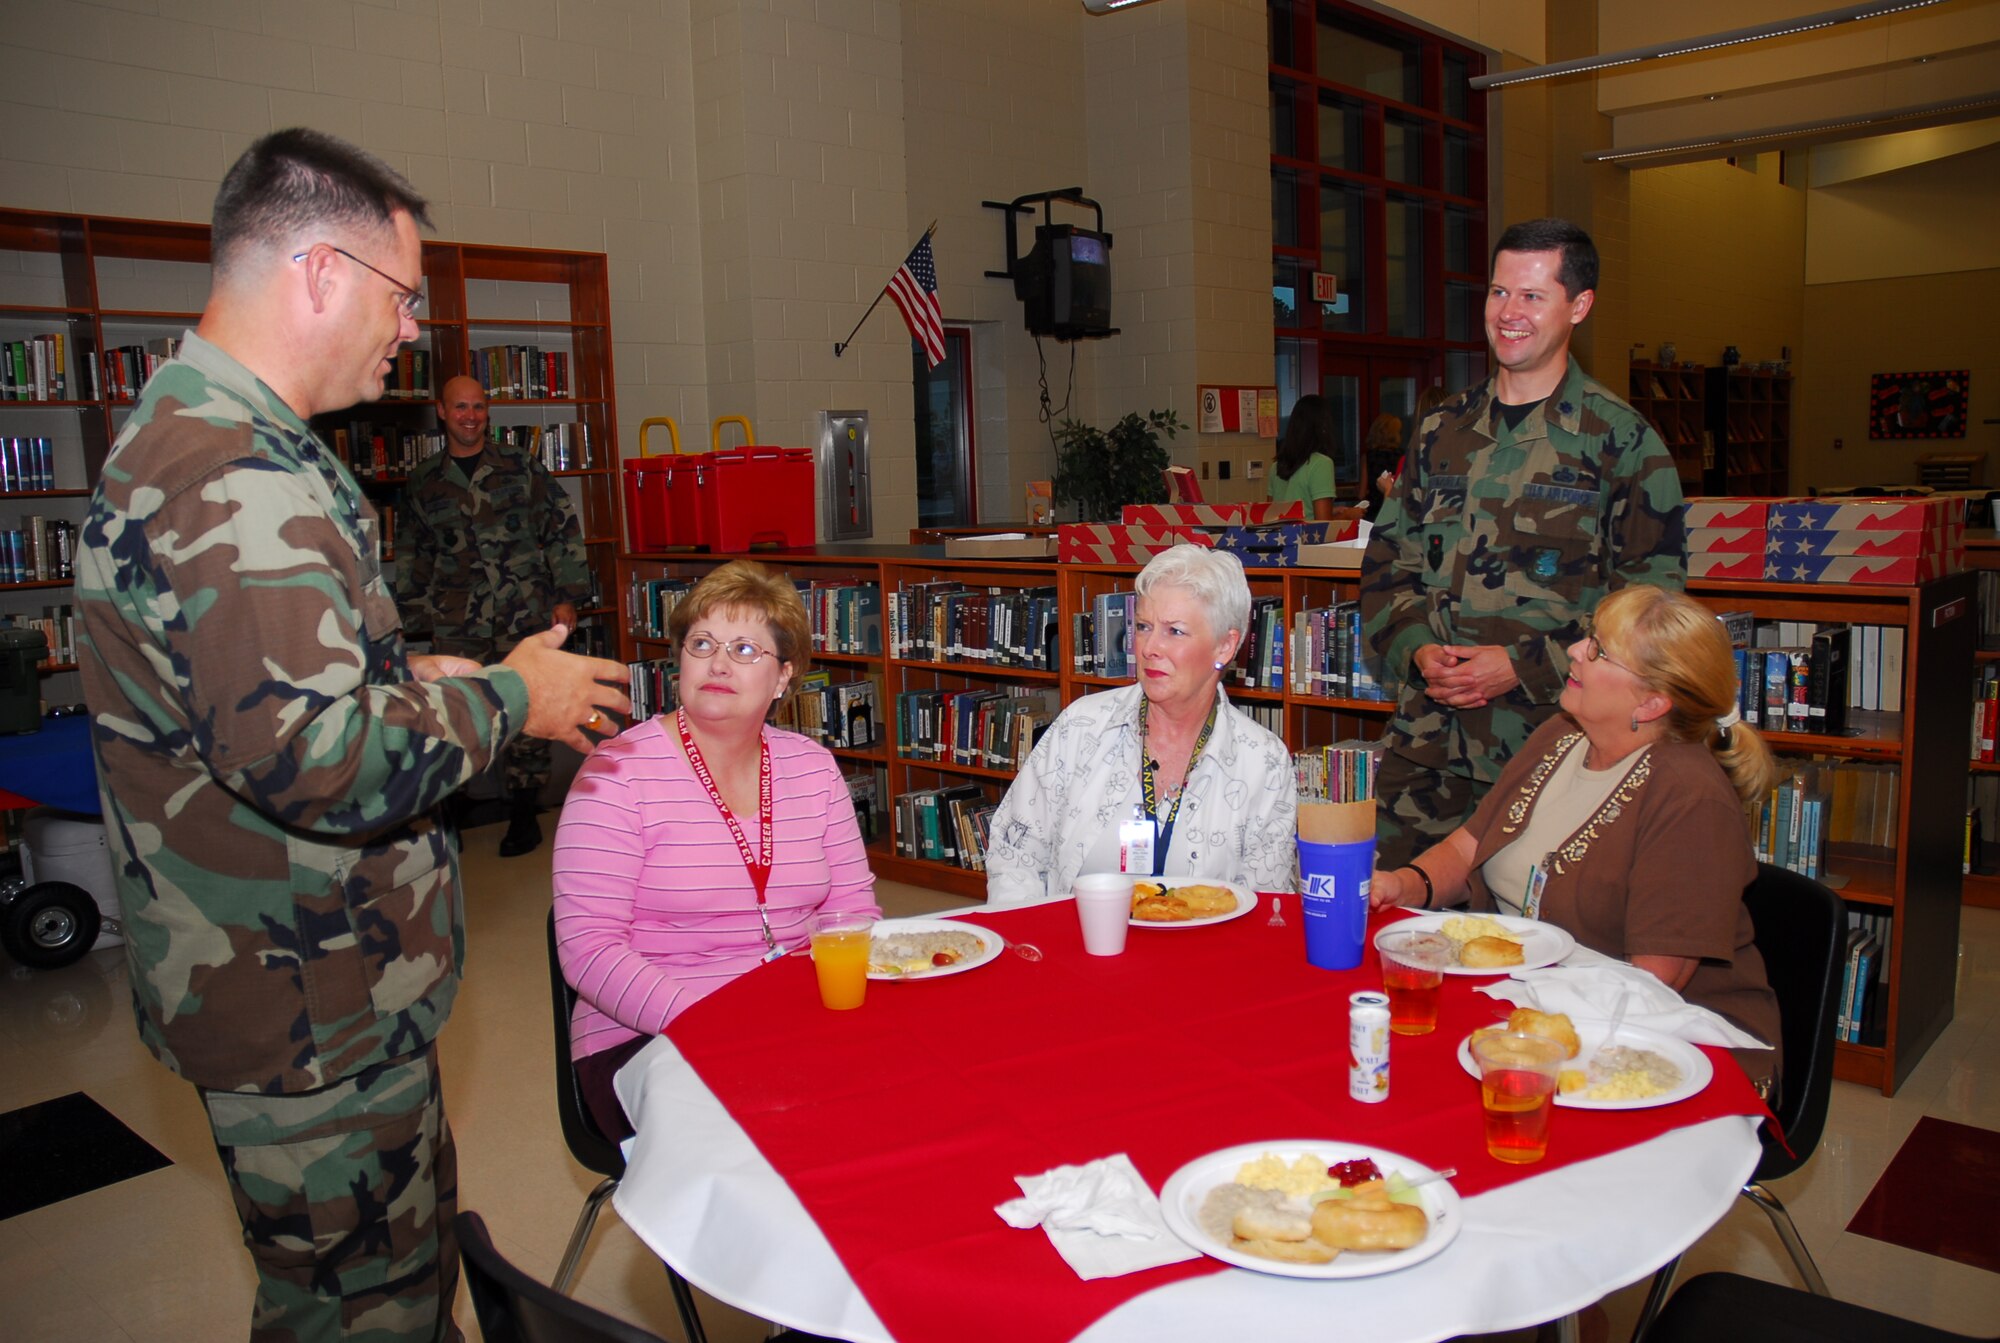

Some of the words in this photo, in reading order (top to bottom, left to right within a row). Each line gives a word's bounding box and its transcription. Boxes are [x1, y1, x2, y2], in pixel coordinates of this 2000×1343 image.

[1317, 274, 1333, 299] EXIT
[684, 739, 729, 814] TECHNOLOGY
[727, 818, 755, 865] CENTER
[761, 750, 772, 818] TECHNOLOGY
[761, 823, 772, 867] CAREER
